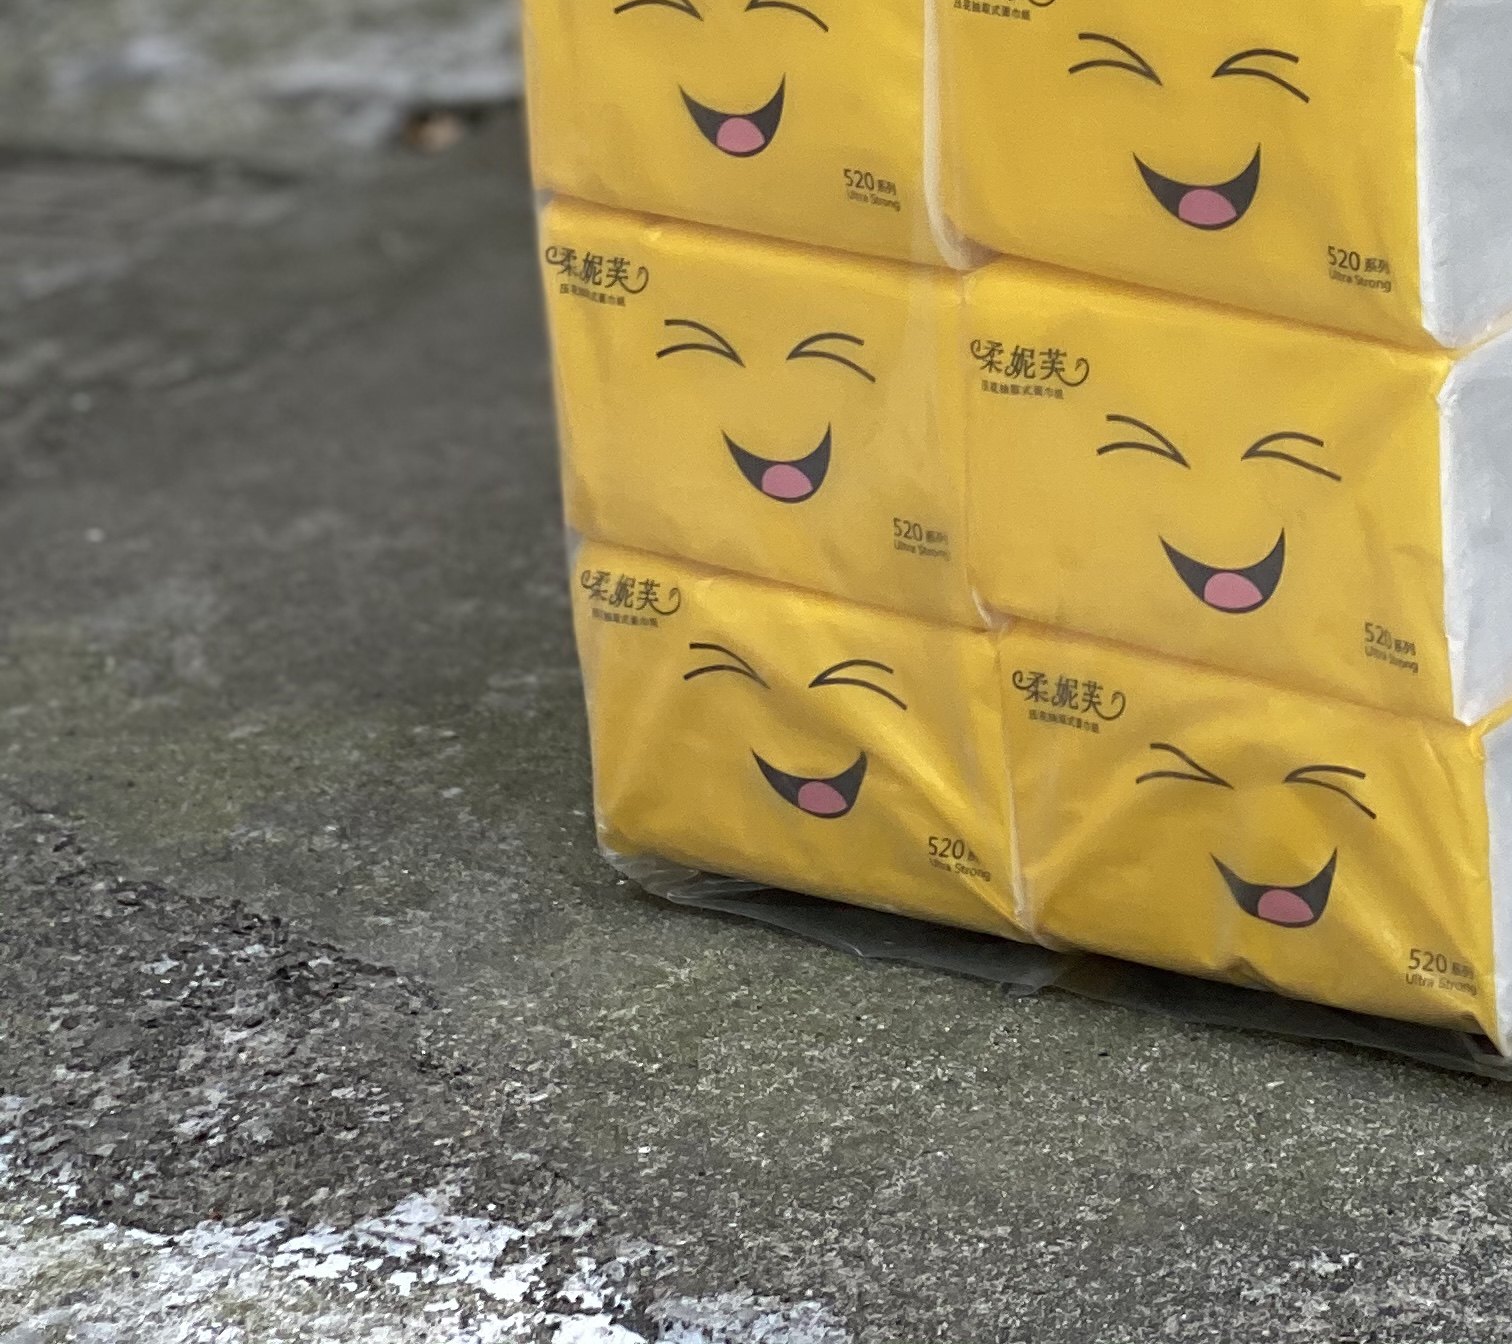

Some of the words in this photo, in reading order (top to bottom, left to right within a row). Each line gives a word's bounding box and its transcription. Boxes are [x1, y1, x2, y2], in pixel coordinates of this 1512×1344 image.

[848, 190, 868, 202] Ultra
[870, 195, 900, 212] Strong
[545, 245, 649, 295] 柔妮芙
[1329, 269, 1352, 284] Ultra
[1356, 274, 1392, 293] Strong
[970, 339, 1090, 387] 柔妮芙
[580, 569, 682, 616] 柔妮芙
[1012, 670, 1126, 721] 柔妮芙
[955, 863, 991, 882] Strong
[1406, 973, 1434, 988] Ultra
[1438, 977, 1477, 996] Strong
